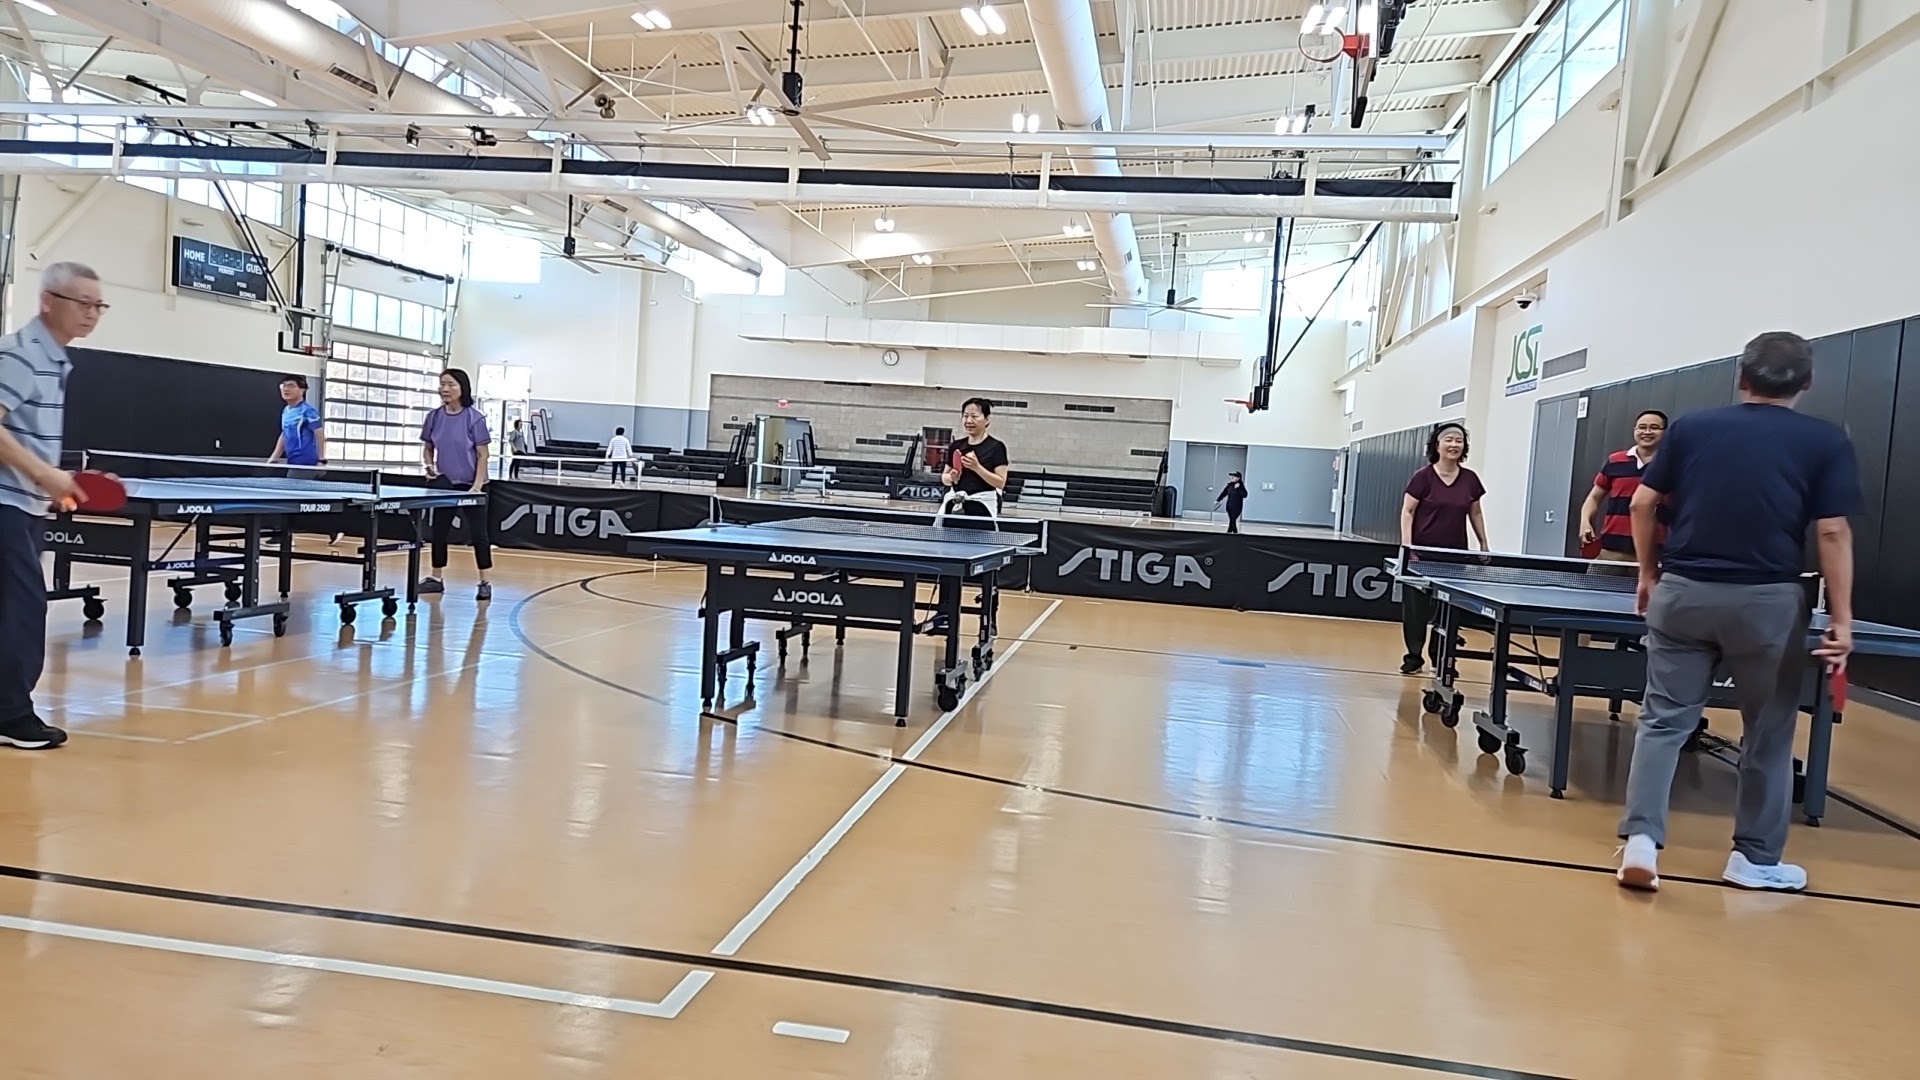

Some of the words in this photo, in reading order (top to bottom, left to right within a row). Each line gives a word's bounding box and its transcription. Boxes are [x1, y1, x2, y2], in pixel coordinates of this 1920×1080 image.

[184, 248, 206, 263] HOME
[218, 267, 235, 276] PERIOD
[193, 281, 212, 291] BONUS
[239, 290, 257, 300] BONUS
[898, 486, 942, 498] STIGA
[184, 505, 213, 514] JOOLA
[300, 503, 317, 513] TOUR
[315, 503, 331, 513] 2500
[500, 504, 631, 538] STIGA
[43, 531, 85, 545] OOLA
[777, 554, 817, 565] JOOLA
[1058, 547, 1212, 590] STIGA
[786, 590, 844, 606] JOOLA
